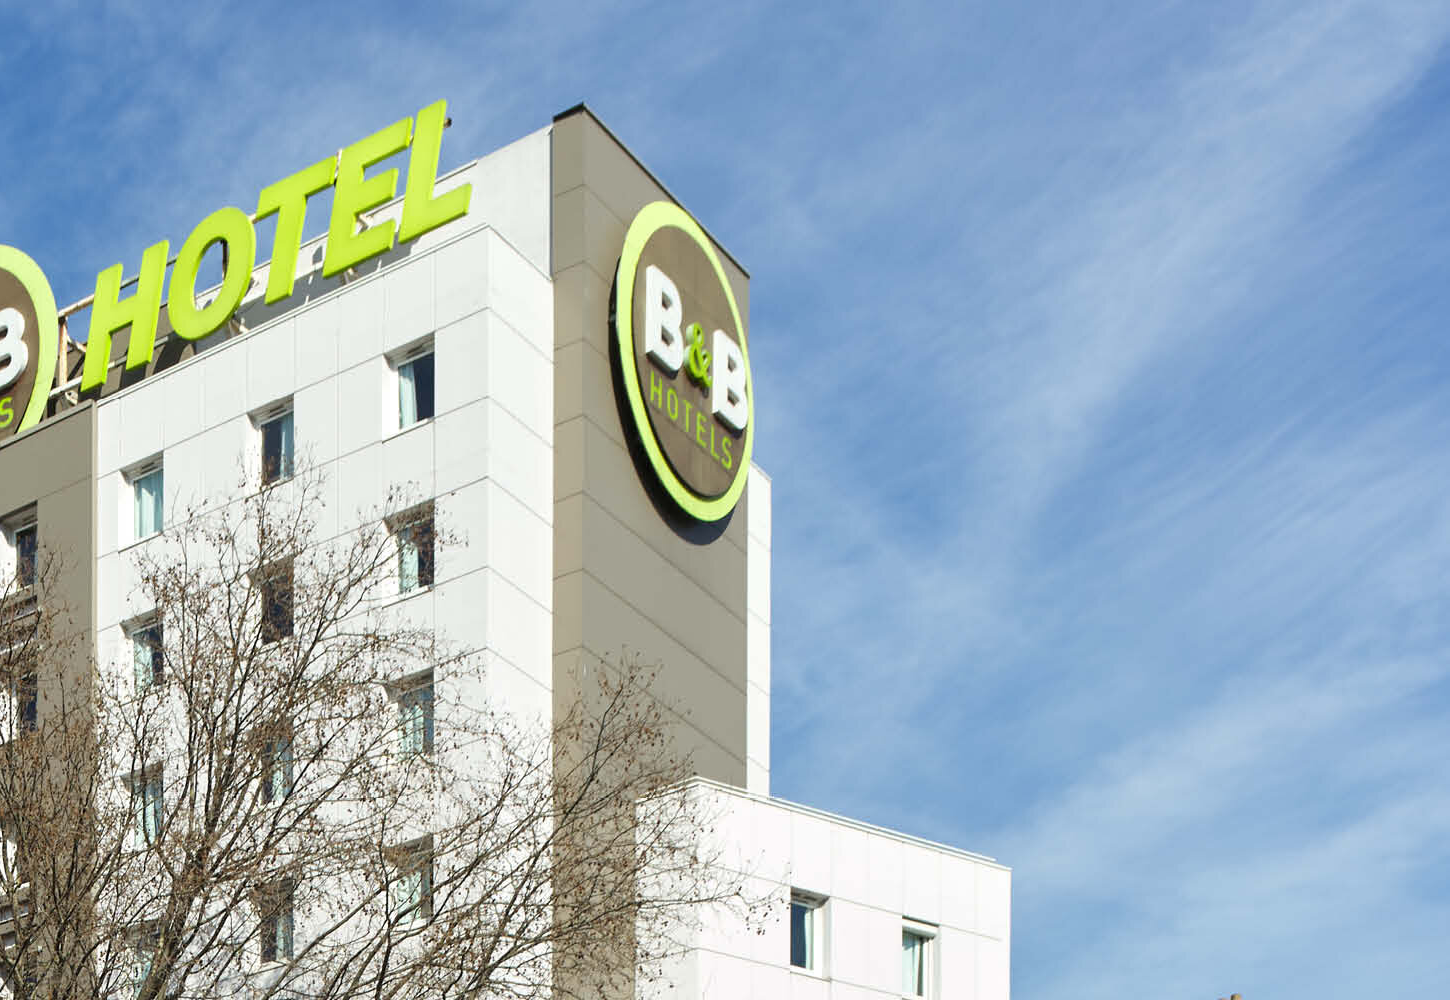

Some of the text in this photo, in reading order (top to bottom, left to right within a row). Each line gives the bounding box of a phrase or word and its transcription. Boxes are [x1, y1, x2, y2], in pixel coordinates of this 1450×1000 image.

[80, 99, 472, 393] HOTEL
[646, 264, 749, 438] B&B
[650, 371, 733, 471] HOTELS
